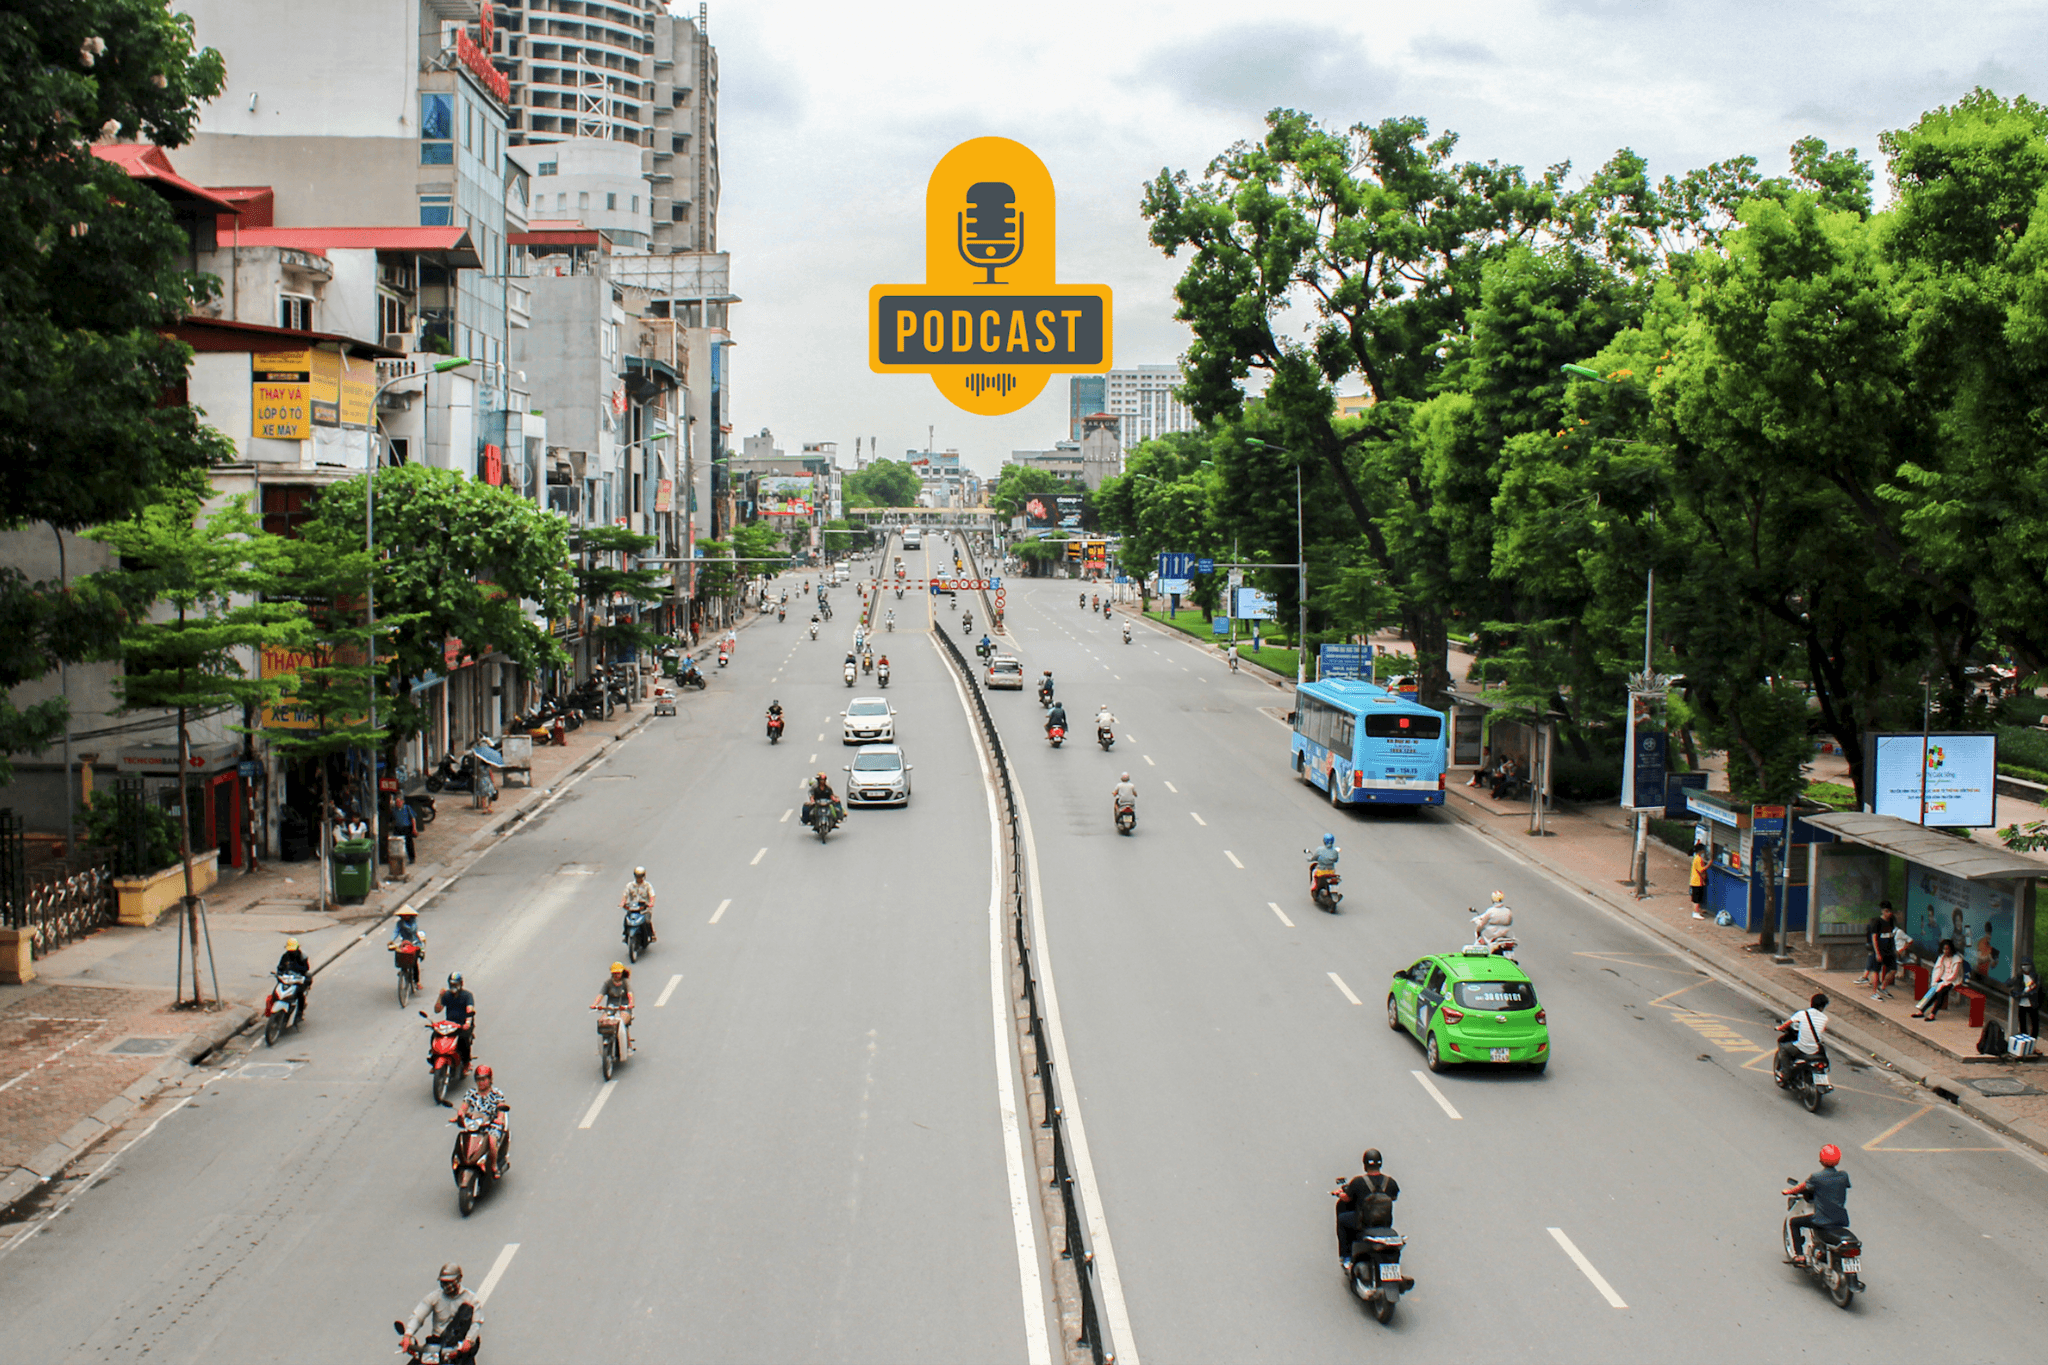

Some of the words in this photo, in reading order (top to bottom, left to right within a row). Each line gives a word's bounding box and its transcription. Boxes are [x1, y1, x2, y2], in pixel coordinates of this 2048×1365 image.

[259, 387, 285, 400] THAY
[262, 423, 276, 436] XE
[264, 652, 304, 671] THAY
[123, 756, 181, 765] TECHCOMBAN
